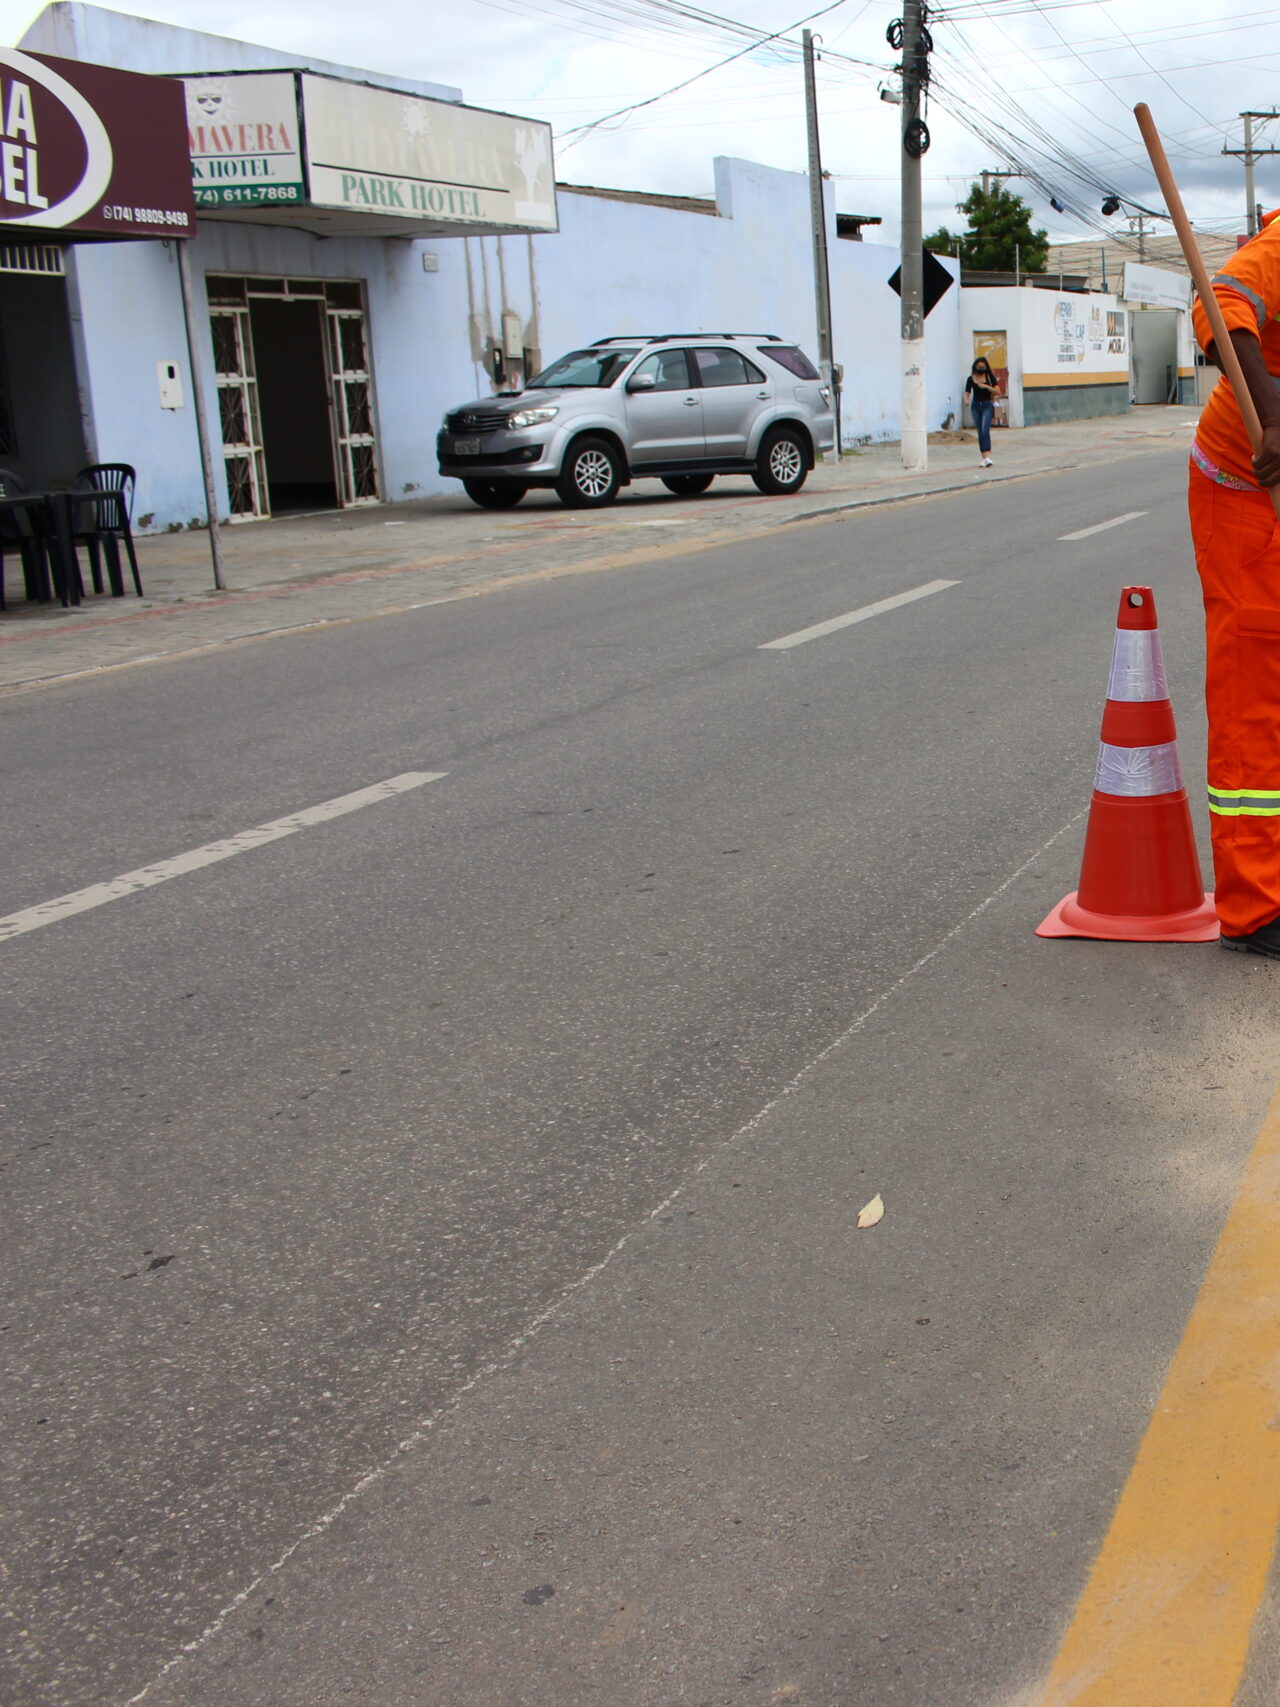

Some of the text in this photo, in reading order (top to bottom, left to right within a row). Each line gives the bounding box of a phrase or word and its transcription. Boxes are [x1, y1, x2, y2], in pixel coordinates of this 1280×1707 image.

[0, 78, 38, 145] A
[0, 141, 49, 210] EL
[209, 158, 275, 178] HOTEL
[223, 186, 297, 202] 611-7868
[341, 173, 486, 218] PARK HOTEL
